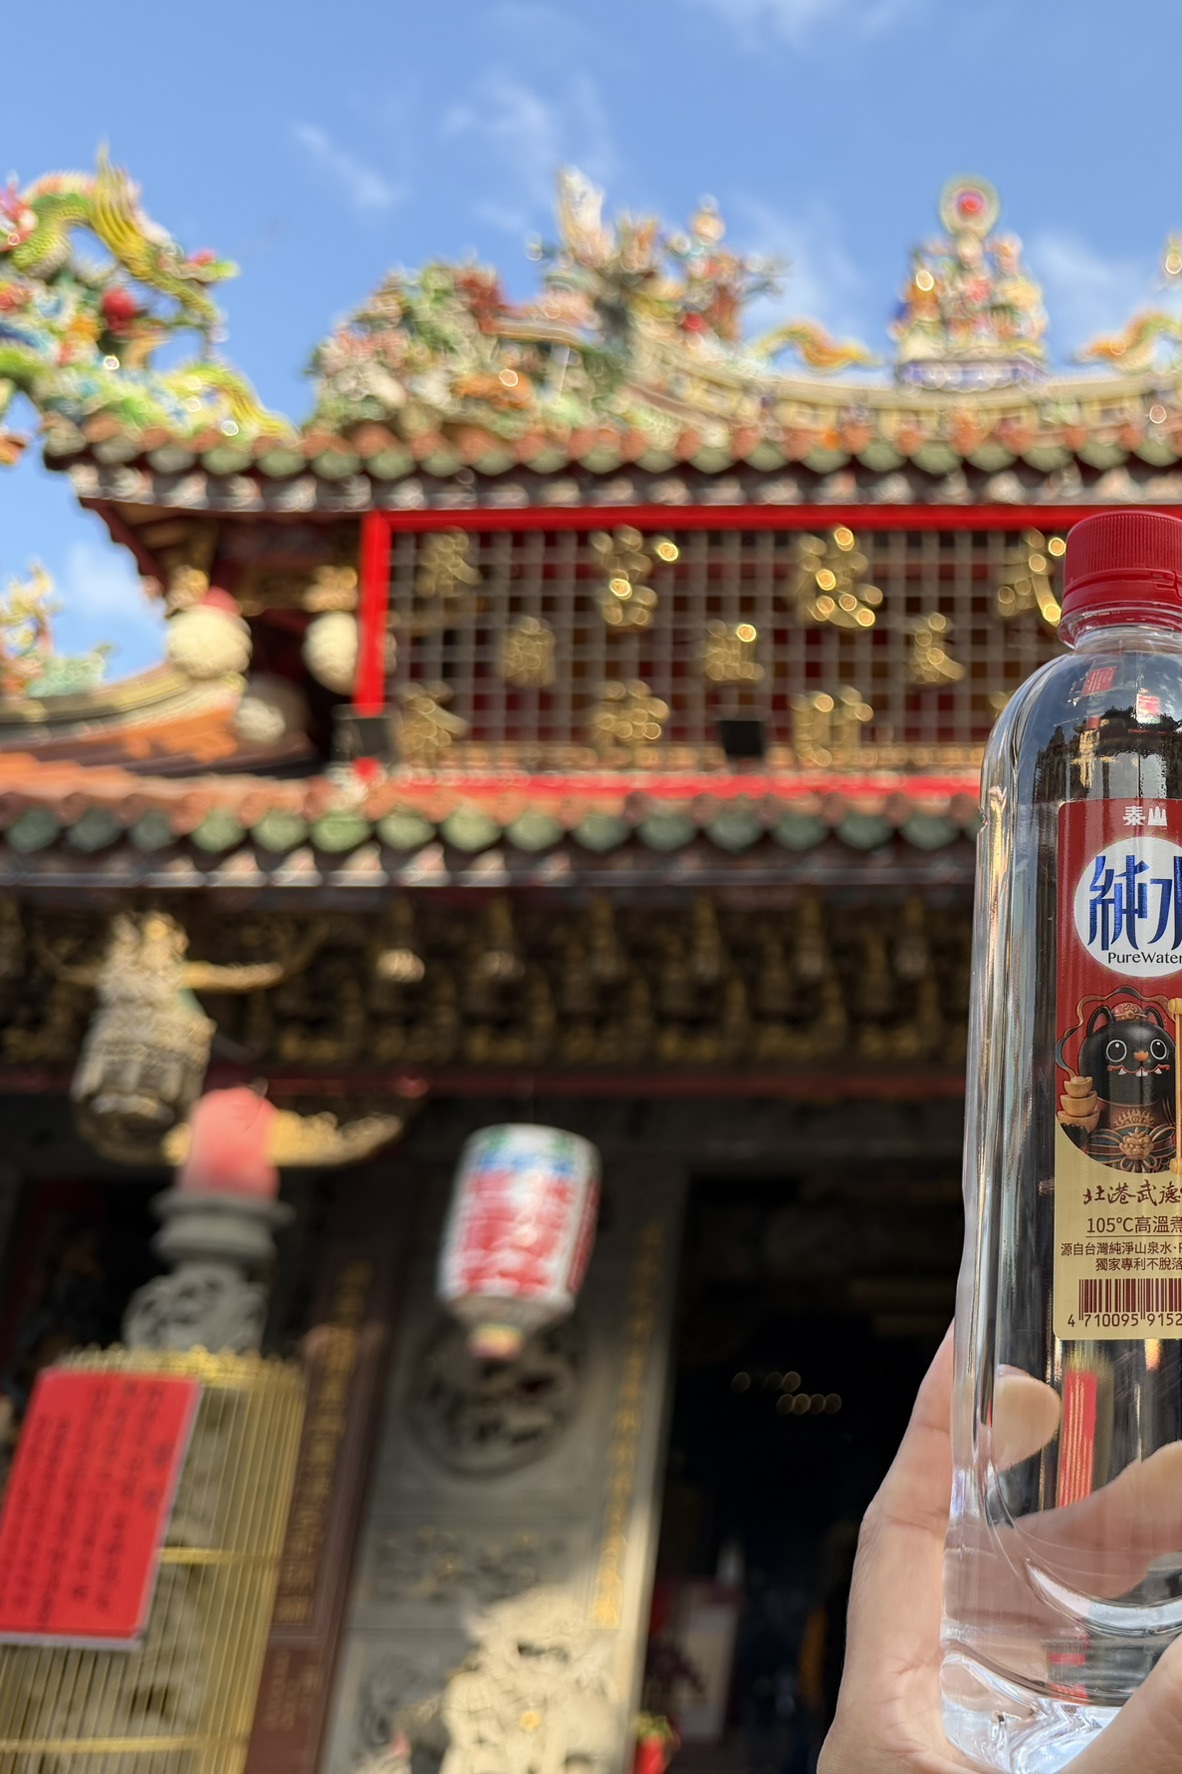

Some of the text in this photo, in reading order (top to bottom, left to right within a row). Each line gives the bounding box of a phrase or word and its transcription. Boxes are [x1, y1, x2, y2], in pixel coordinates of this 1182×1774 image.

[1122, 805, 1168, 827] 泰山
[1067, 1313, 1076, 1328] 4
[1084, 1313, 1139, 1327] 710095
